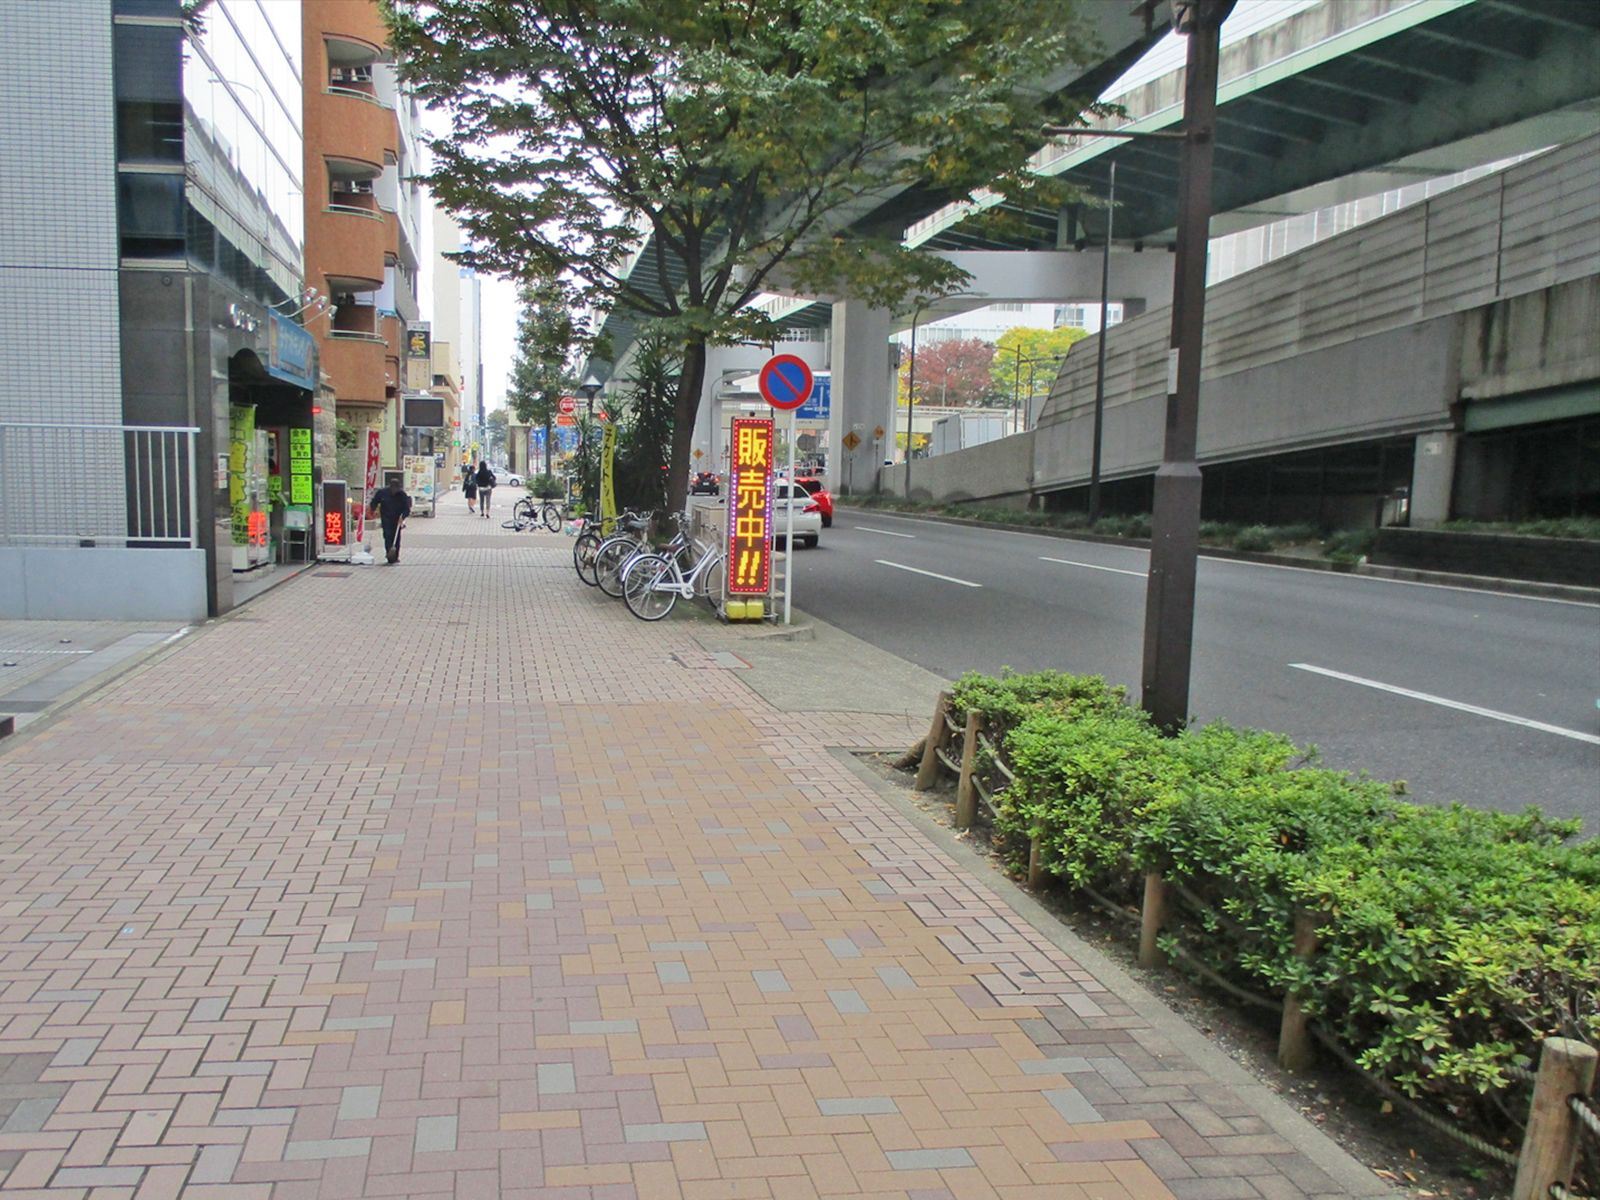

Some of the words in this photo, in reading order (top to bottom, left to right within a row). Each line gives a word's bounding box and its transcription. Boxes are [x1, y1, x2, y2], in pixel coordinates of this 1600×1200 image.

[325, 511, 343, 545] 格安
[736, 428, 768, 586] 販売中!!
